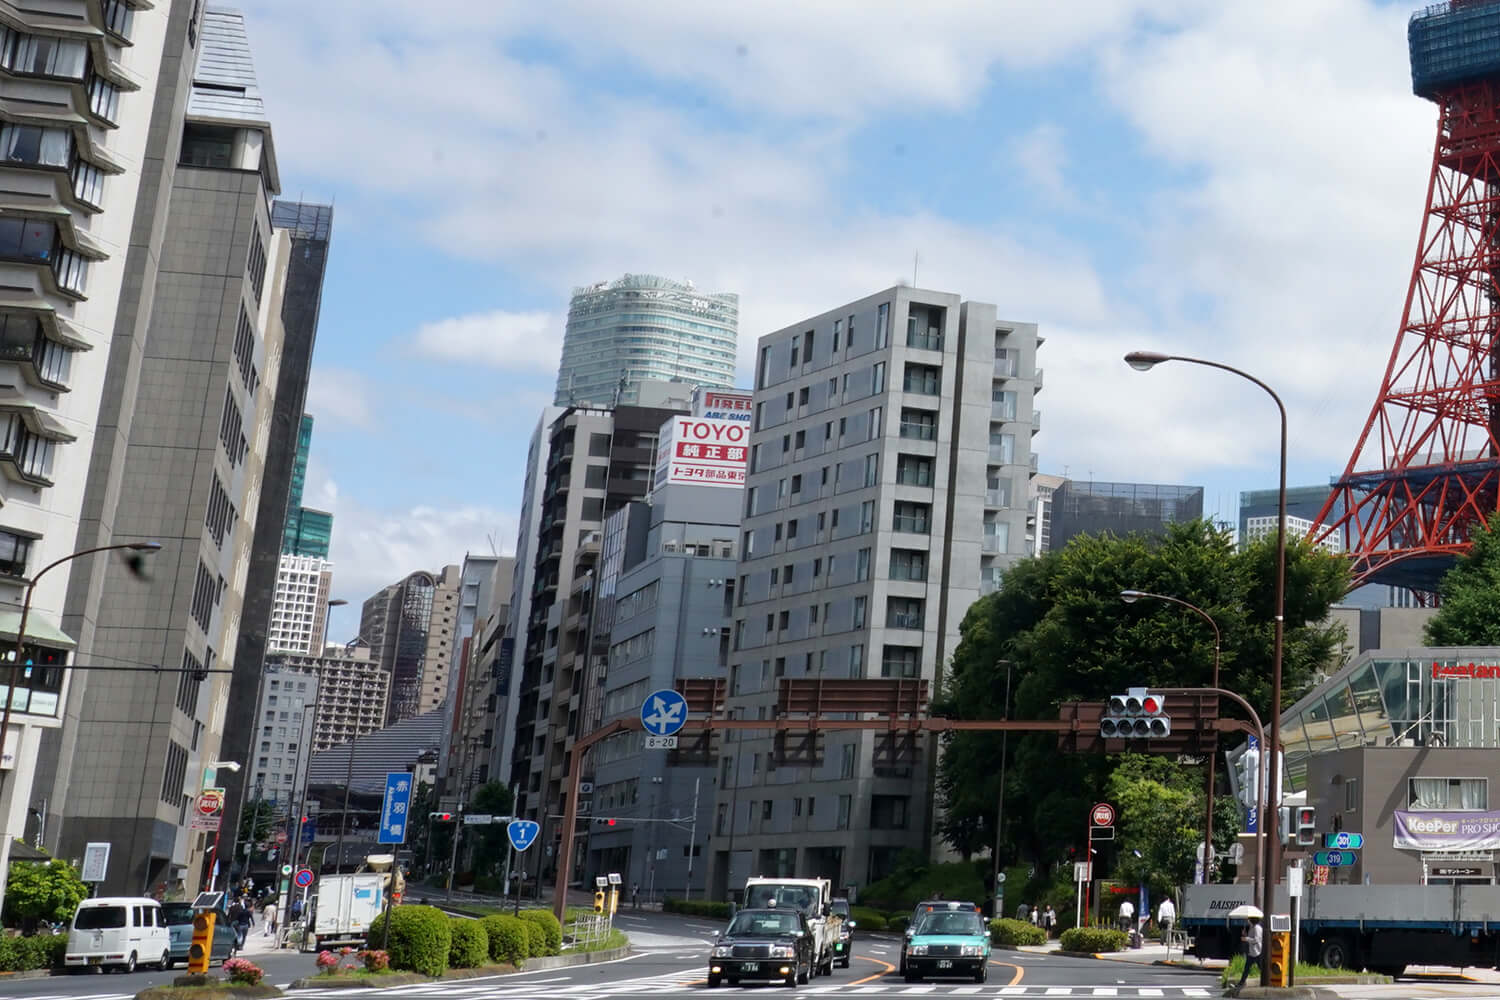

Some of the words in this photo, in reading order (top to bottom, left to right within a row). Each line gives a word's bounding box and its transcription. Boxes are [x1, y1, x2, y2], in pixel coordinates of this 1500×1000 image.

[649, 738, 674, 747] 8-20
[1407, 817, 1457, 834] KeePer
[1461, 823, 1482, 835] PRO
[519, 828, 526, 839] 1
[1328, 854, 1341, 864] 319
